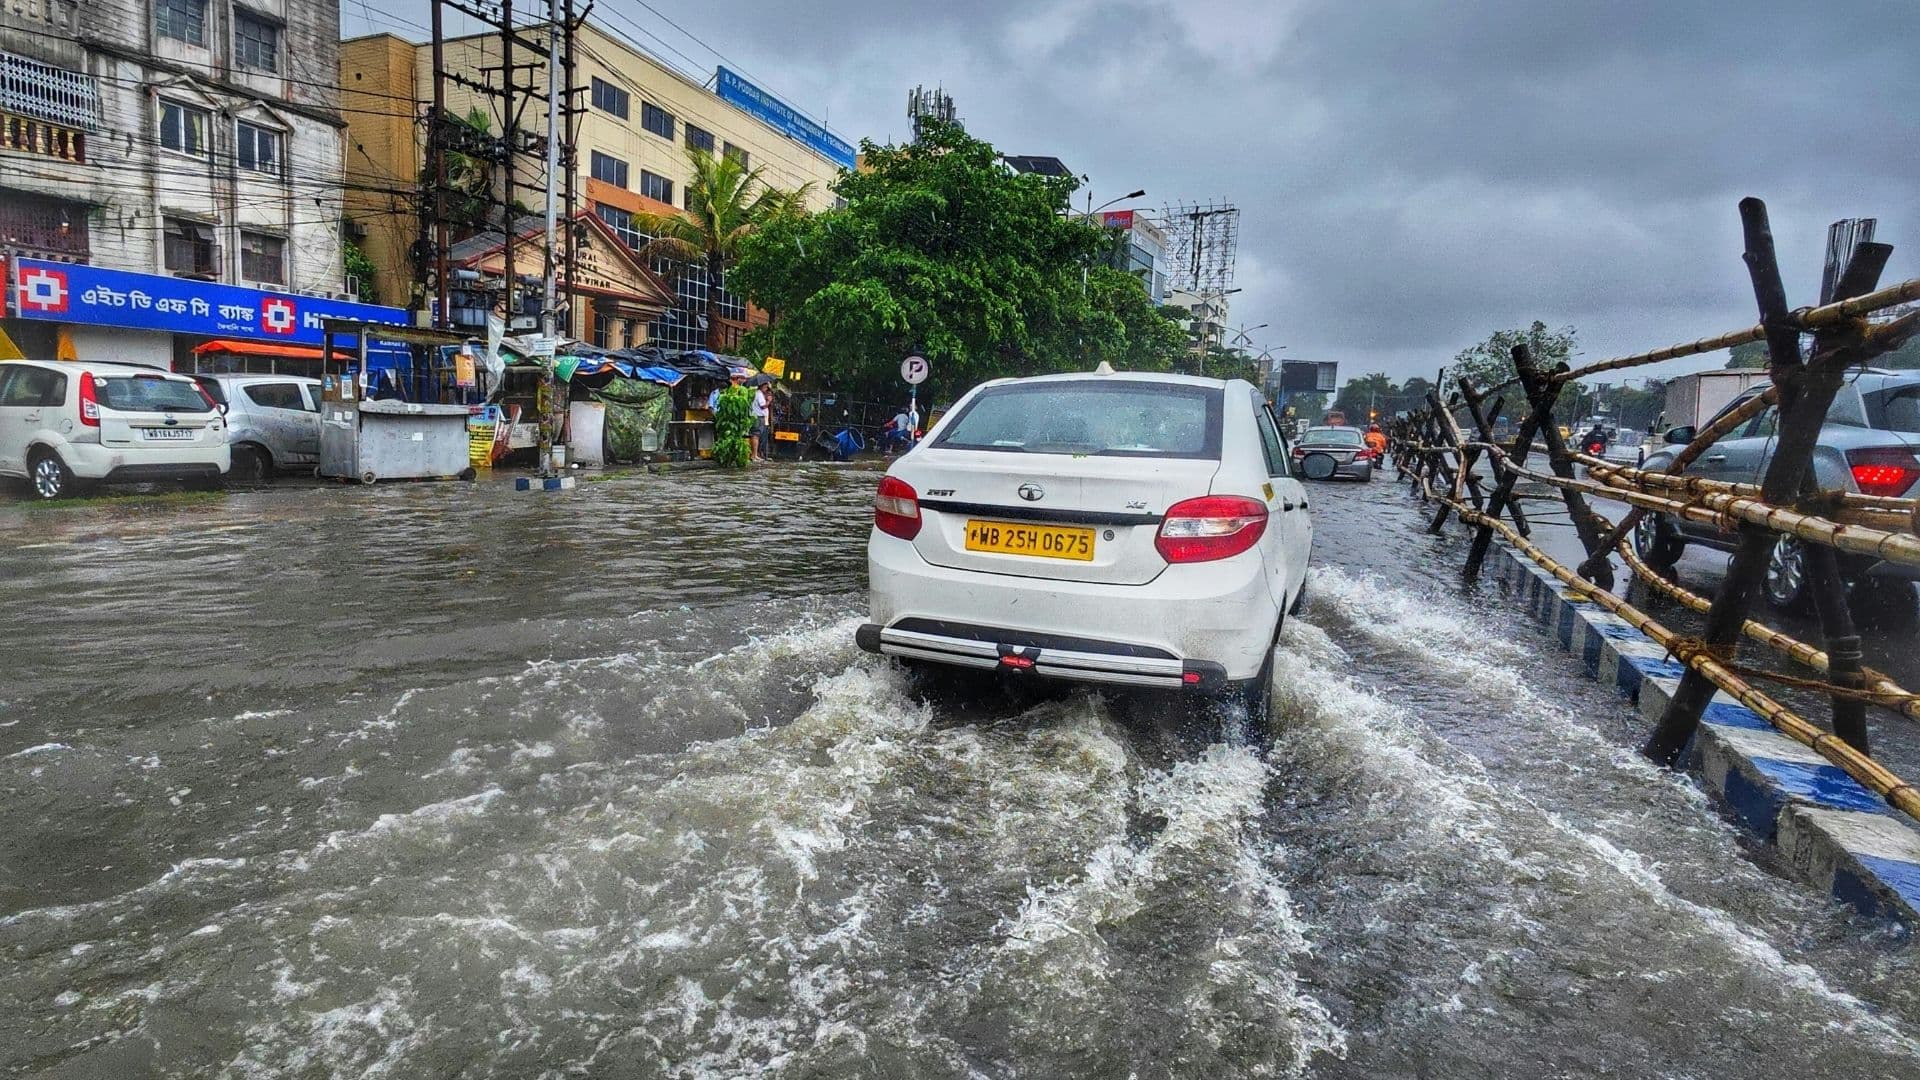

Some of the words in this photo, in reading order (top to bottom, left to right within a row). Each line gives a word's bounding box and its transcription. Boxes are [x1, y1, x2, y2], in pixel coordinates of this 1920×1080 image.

[81, 285, 126, 307] এইচ
[129, 290, 152, 309] ডি
[155, 298, 187, 315] এফ
[980, 527, 1000, 545] WB
[1005, 529, 1038, 550] 25H
[1042, 532, 1089, 554] 0675
